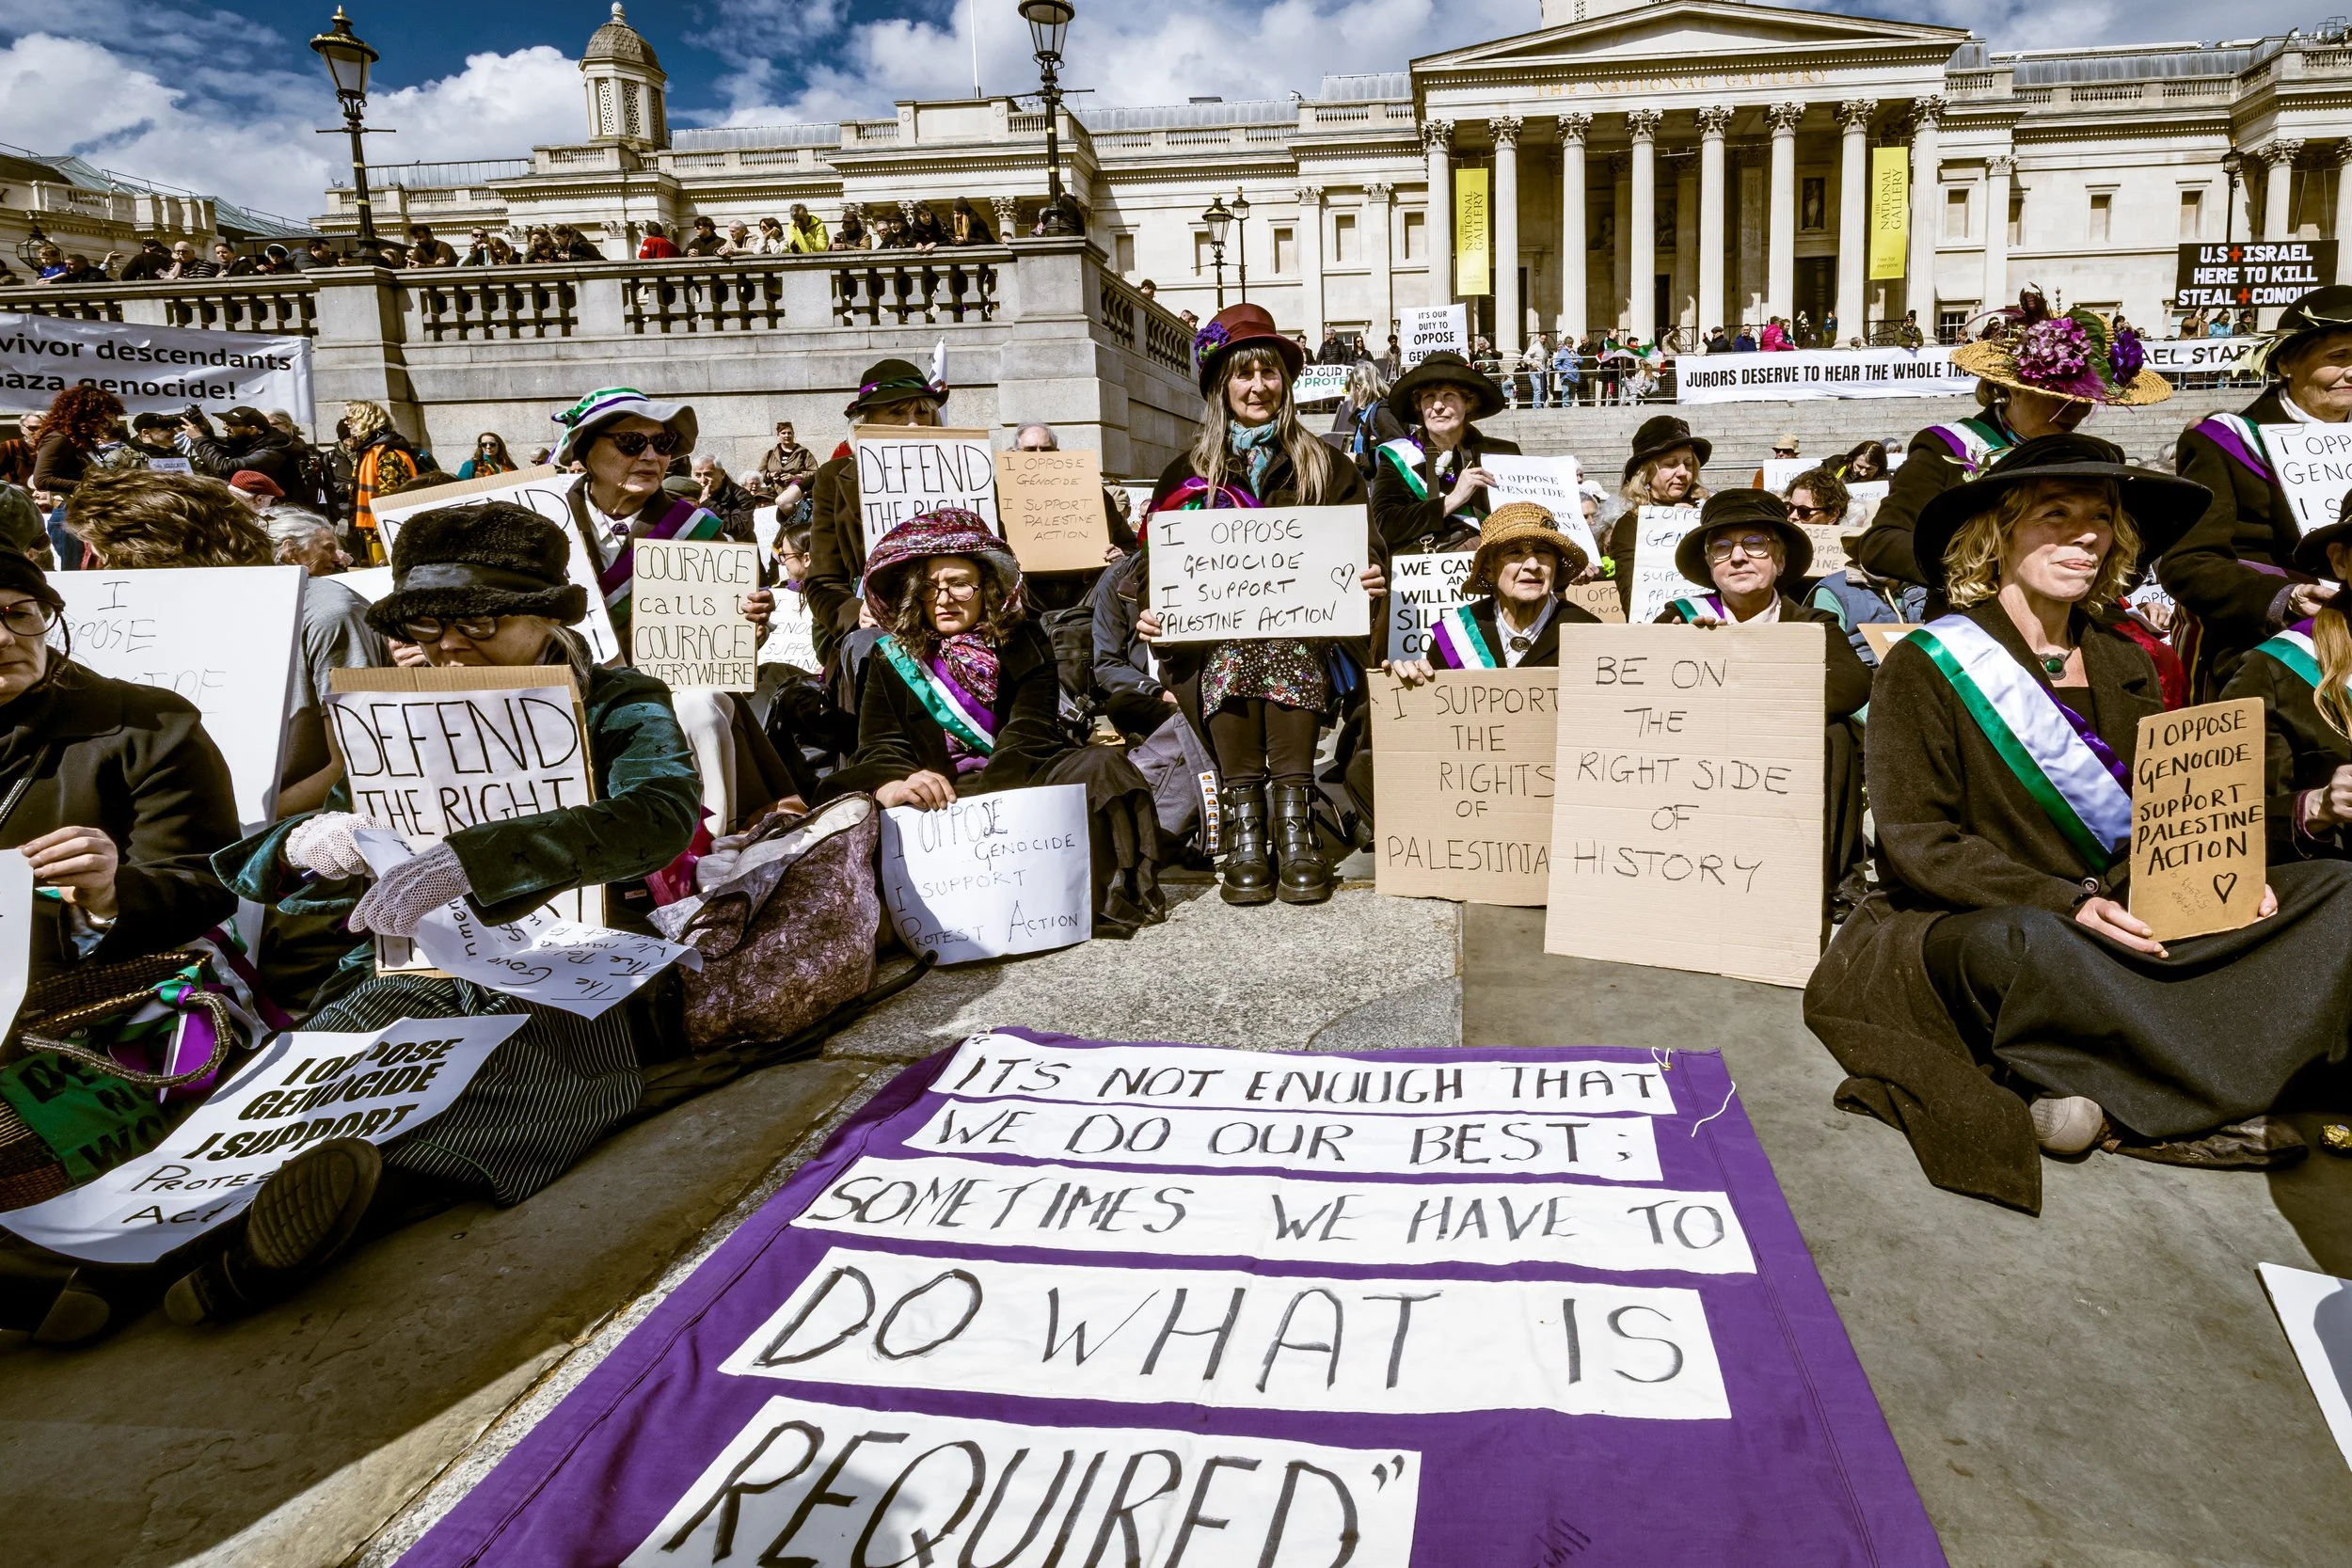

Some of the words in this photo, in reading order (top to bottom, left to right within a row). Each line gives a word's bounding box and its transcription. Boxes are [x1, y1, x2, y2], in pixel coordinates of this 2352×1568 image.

[1537, 84, 1577, 97] THE
[1594, 76, 1708, 93] NATIONAL
[1725, 70, 1828, 87] GALLERY
[1881, 168, 1891, 230] NATIONAL
[1891, 168, 1902, 230] GALLERY
[1465, 191, 1473, 251] NATIONAL
[1474, 192, 1484, 251] GALLERY
[2194, 267, 2239, 284] HERE
[2244, 266, 2266, 283] TO
[2271, 265, 2318, 282] KILL
[1432, 310, 1447, 319] OUR
[1414, 331, 1454, 345] OPPOSE
[96, 341, 292, 371] descendants
[1317, 367, 1342, 376] OUR
[78, 377, 236, 400] genocide!
[1686, 370, 1737, 388] JURORS
[1741, 366, 1800, 384] DESERVE
[1804, 365, 1820, 382] TO
[1825, 365, 1860, 382] HEAR
[1866, 364, 1888, 380] THE
[1893, 361, 1942, 379] WHOLE
[2280, 436, 2289, 455] I
[860, 445, 992, 494] DEFEND
[1003, 456, 1016, 471] I
[1025, 458, 1085, 470] OPPOSE
[1016, 473, 1081, 486] GENOCIDE
[1508, 474, 1559, 485] OPPOSE
[1003, 498, 1013, 510] I
[1025, 498, 1092, 511] SUPPORT
[1497, 485, 1565, 499] GENOCIDE
[865, 501, 902, 534] THE
[1025, 515, 1096, 528] PALESTINE
[2299, 498, 2309, 520] I
[1034, 530, 1089, 541] ACTION
[1160, 522, 1184, 546] I
[1211, 518, 1303, 544] OPPOSE
[636, 546, 753, 584] COURAGE
[1184, 551, 1304, 579] GENOCIDE
[1401, 561, 1432, 576] WE
[98, 581, 131, 610] I
[640, 594, 716, 615] calls
[1162, 585, 1182, 609] I
[1199, 578, 1296, 602] SUPPORT
[1401, 589, 1447, 605] WILL
[1156, 610, 1246, 635] PALESTINE
[1258, 600, 1336, 631] ACTION
[635, 625, 753, 660] COURAGE
[1596, 657, 1648, 686] BE
[1672, 658, 1726, 689] ON
[1391, 687, 1408, 721] I
[1435, 685, 1559, 716] SUPPORT
[333, 697, 579, 778] DEFEND
[1624, 707, 1688, 737] THE
[2149, 728, 2154, 750] I
[2164, 709, 2248, 746] OPPOSE
[1450, 725, 1505, 752] THE
[1439, 761, 1555, 799] RIGHTS
[1577, 752, 1680, 784] RIGHT
[1692, 759, 1791, 795] SIDE
[2138, 743, 2252, 793] GENOCIDE
[2185, 777, 2191, 794] I
[357, 789, 435, 836] THE
[439, 777, 575, 833] RIGHT
[1455, 800, 1488, 817] OF
[1651, 804, 1699, 831] OF
[2139, 784, 2247, 822] SUPPORT
[892, 815, 905, 860] I
[918, 798, 1008, 853] OPPOSE
[2137, 805, 2264, 854] PALESTINE
[975, 833, 1076, 871] GENOCIDE
[1574, 840, 1762, 893] HISTORY
[2147, 832, 2247, 876] ACTION
[896, 886, 907, 912] I
[921, 869, 1025, 898] SUPPORT
[900, 917, 985, 949] PROTEST
[1009, 900, 1079, 942] ACTION
[1098, 1066, 1225, 1099] NOT
[1246, 1068, 1464, 1105] ENOUGH
[1501, 1065, 1658, 1100] THAT
[207, 1103, 420, 1161] SUPPORT
[936, 1108, 1037, 1147] WE
[1065, 1114, 1171, 1154] DO
[1208, 1121, 1355, 1162] OUR
[807, 1176, 1195, 1233] SOMETIMES
[1271, 1194, 1365, 1243] WE
[1406, 1195, 1579, 1244] HAVE
[1628, 1199, 1726, 1250] TO
[753, 1264, 983, 1368] DO
[1042, 1287, 1444, 1392] WHAT
[1564, 1297, 1684, 1385] IS
